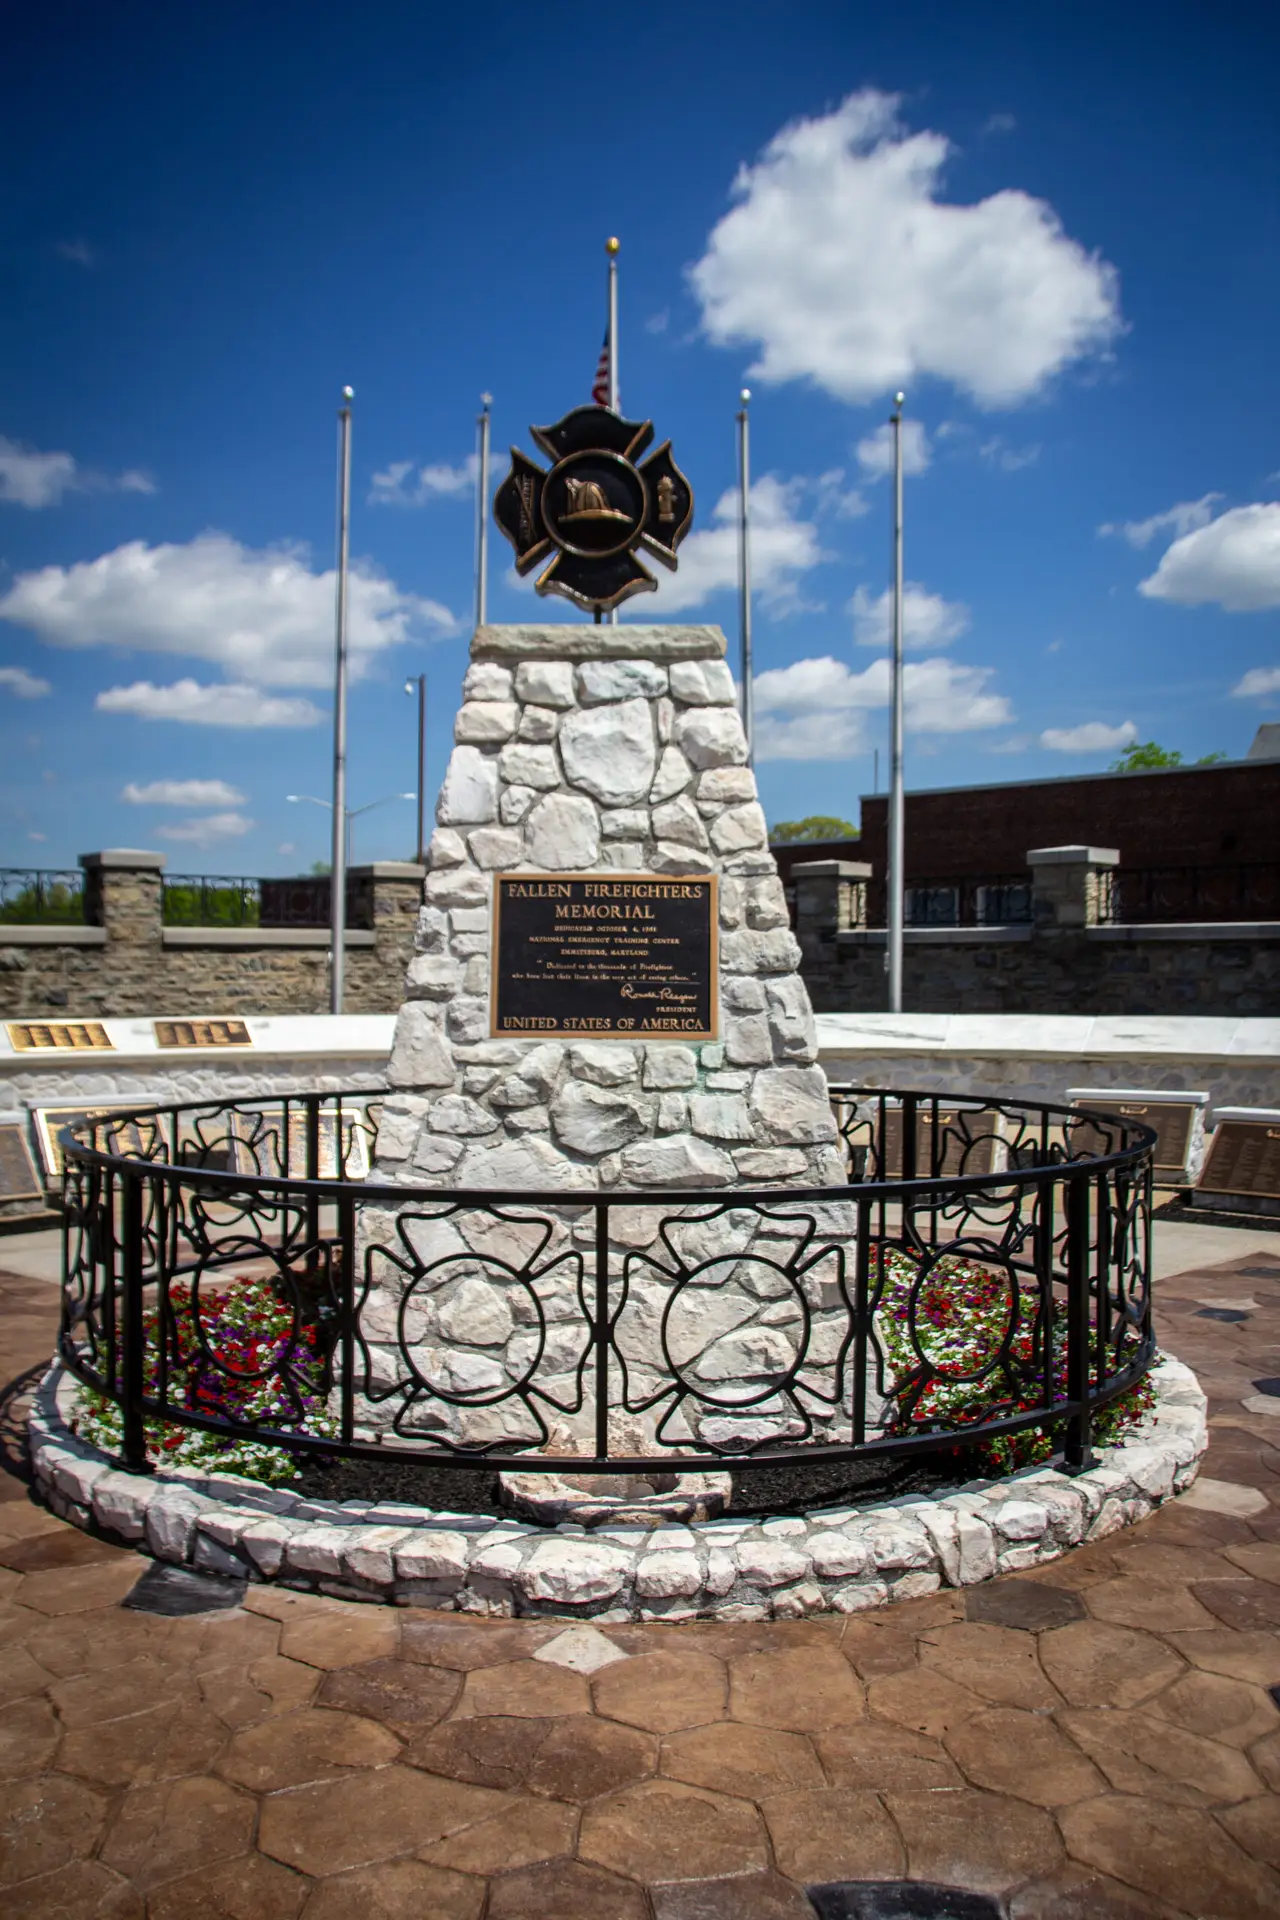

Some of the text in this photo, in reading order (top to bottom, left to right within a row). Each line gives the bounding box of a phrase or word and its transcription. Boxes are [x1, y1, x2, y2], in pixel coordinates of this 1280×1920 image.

[508, 884, 703, 899] FALLEN FIREFIGHTERS
[555, 904, 655, 919] MEMORIAL
[560, 948, 608, 956] EMMITSBURG,
[503, 1017, 704, 1030] UNITED STATES OF AMERICA
